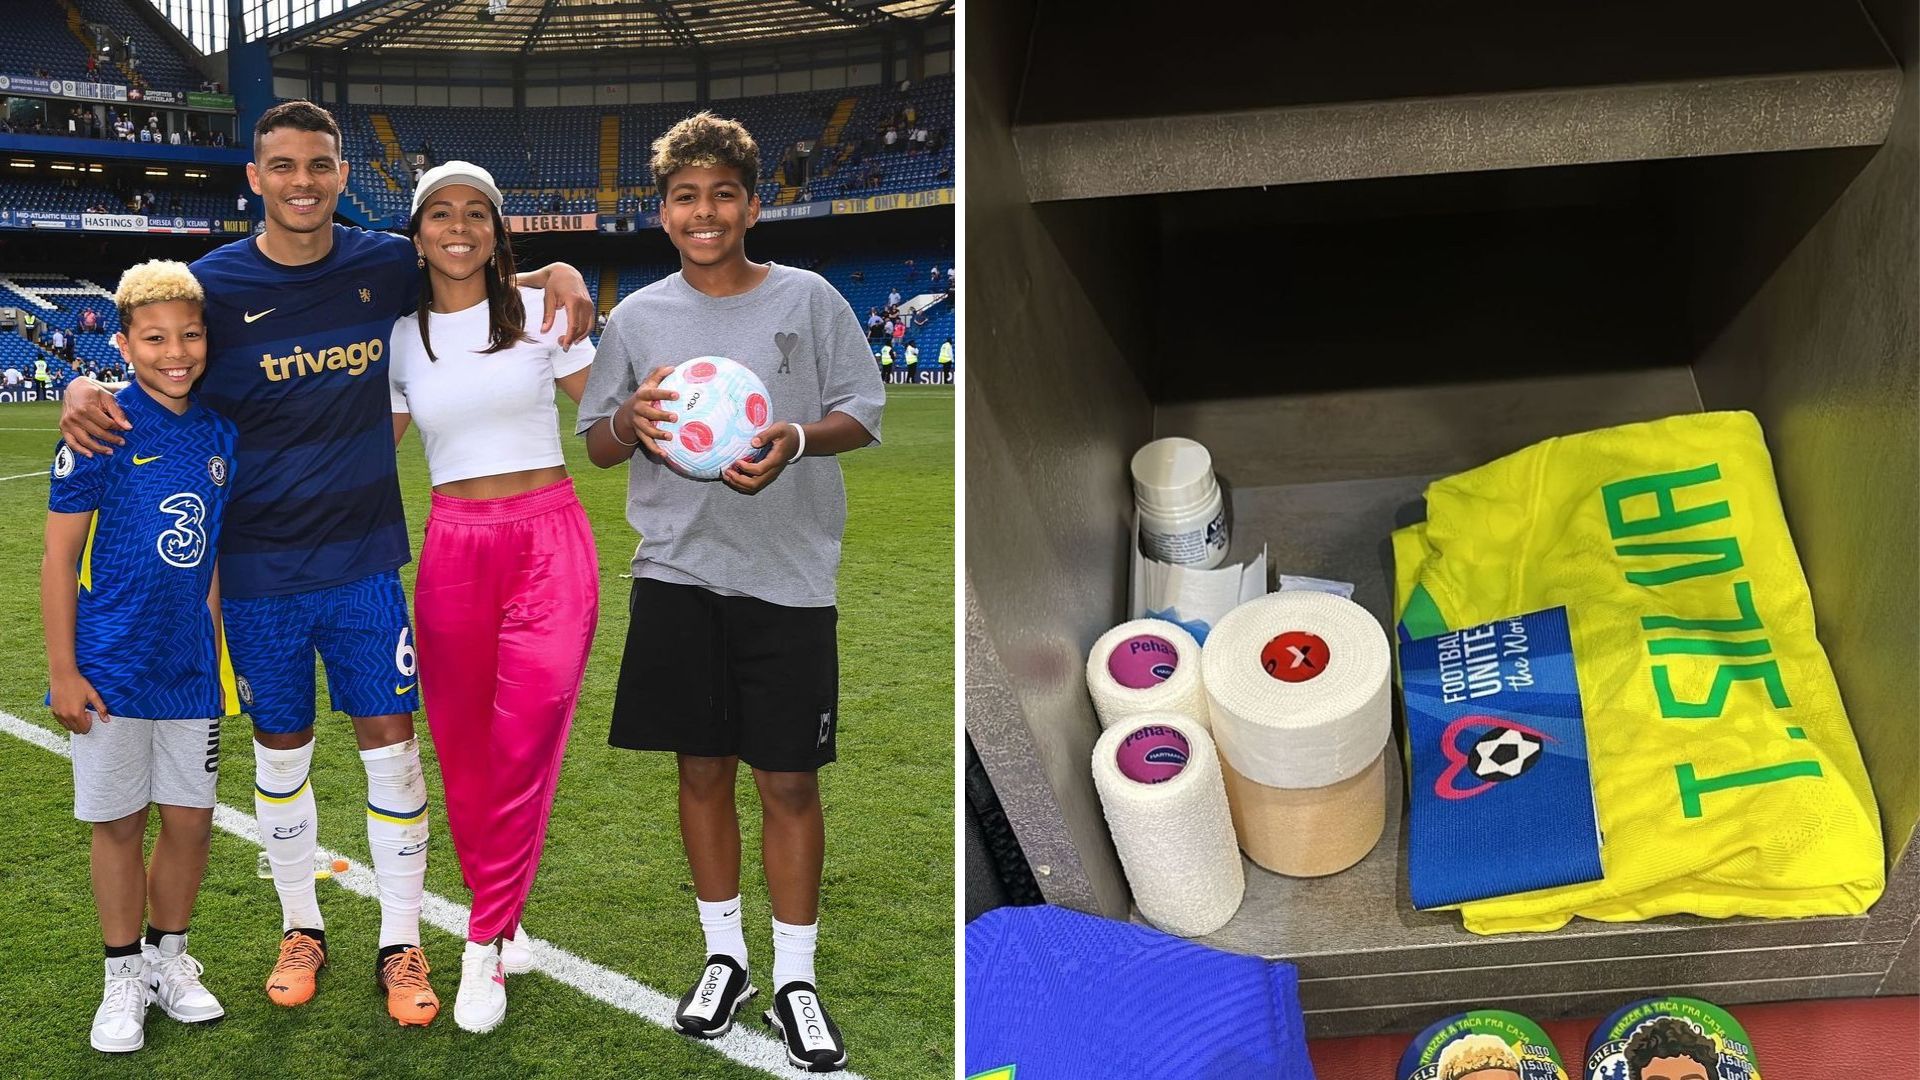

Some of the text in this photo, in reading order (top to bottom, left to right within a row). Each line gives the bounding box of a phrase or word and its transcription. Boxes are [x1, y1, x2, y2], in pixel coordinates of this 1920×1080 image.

[851, 200, 869, 212] THE
[874, 194, 902, 210] ONLY
[907, 189, 941, 208] PLACE
[16, 212, 60, 220] MID-ATLANTIC
[791, 205, 811, 217] FIRST
[84, 217, 132, 228] HASTINGS
[149, 219, 209, 228] CHELSEA ICELAND
[523, 215, 582, 232] LEGEND
[260, 338, 383, 382] trivago
[395, 626, 416, 677] 6
[1462, 623, 1503, 699] UNITE
[1504, 656, 1535, 692] the
[274, 819, 308, 835] CFC
[797, 995, 824, 1042] DOLCE
[1642, 1003, 1654, 1016] A
[1682, 1004, 1701, 1018] PRA
[1446, 1023, 1458, 1035] A
[1485, 1017, 1504, 1029] PRA
